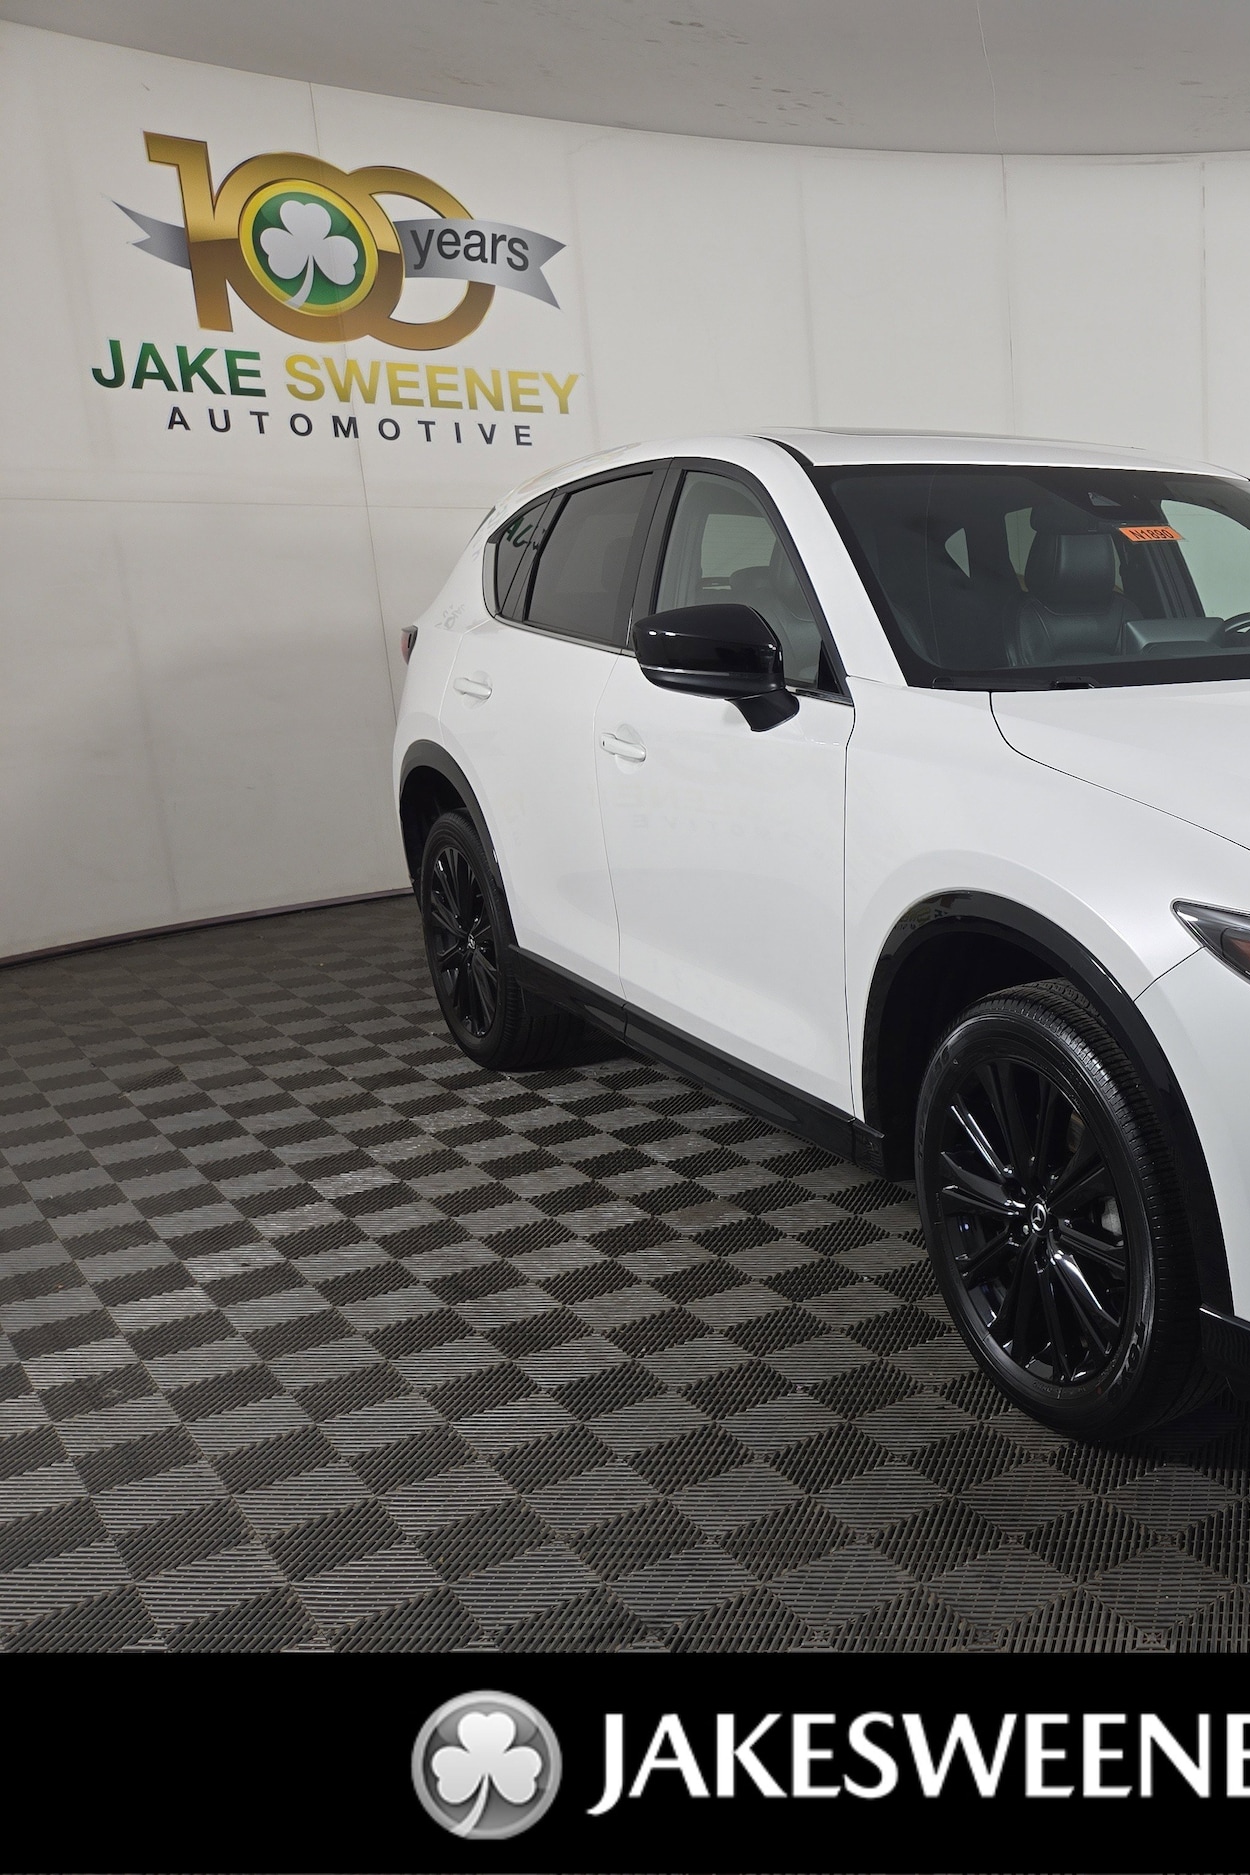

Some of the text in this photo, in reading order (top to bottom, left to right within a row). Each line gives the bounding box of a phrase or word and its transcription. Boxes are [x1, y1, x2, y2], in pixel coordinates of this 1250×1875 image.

[142, 131, 529, 351] 100 years
[91, 339, 579, 415] JAKE SWEENEY
[167, 406, 532, 447] AUTOMOTIVE
